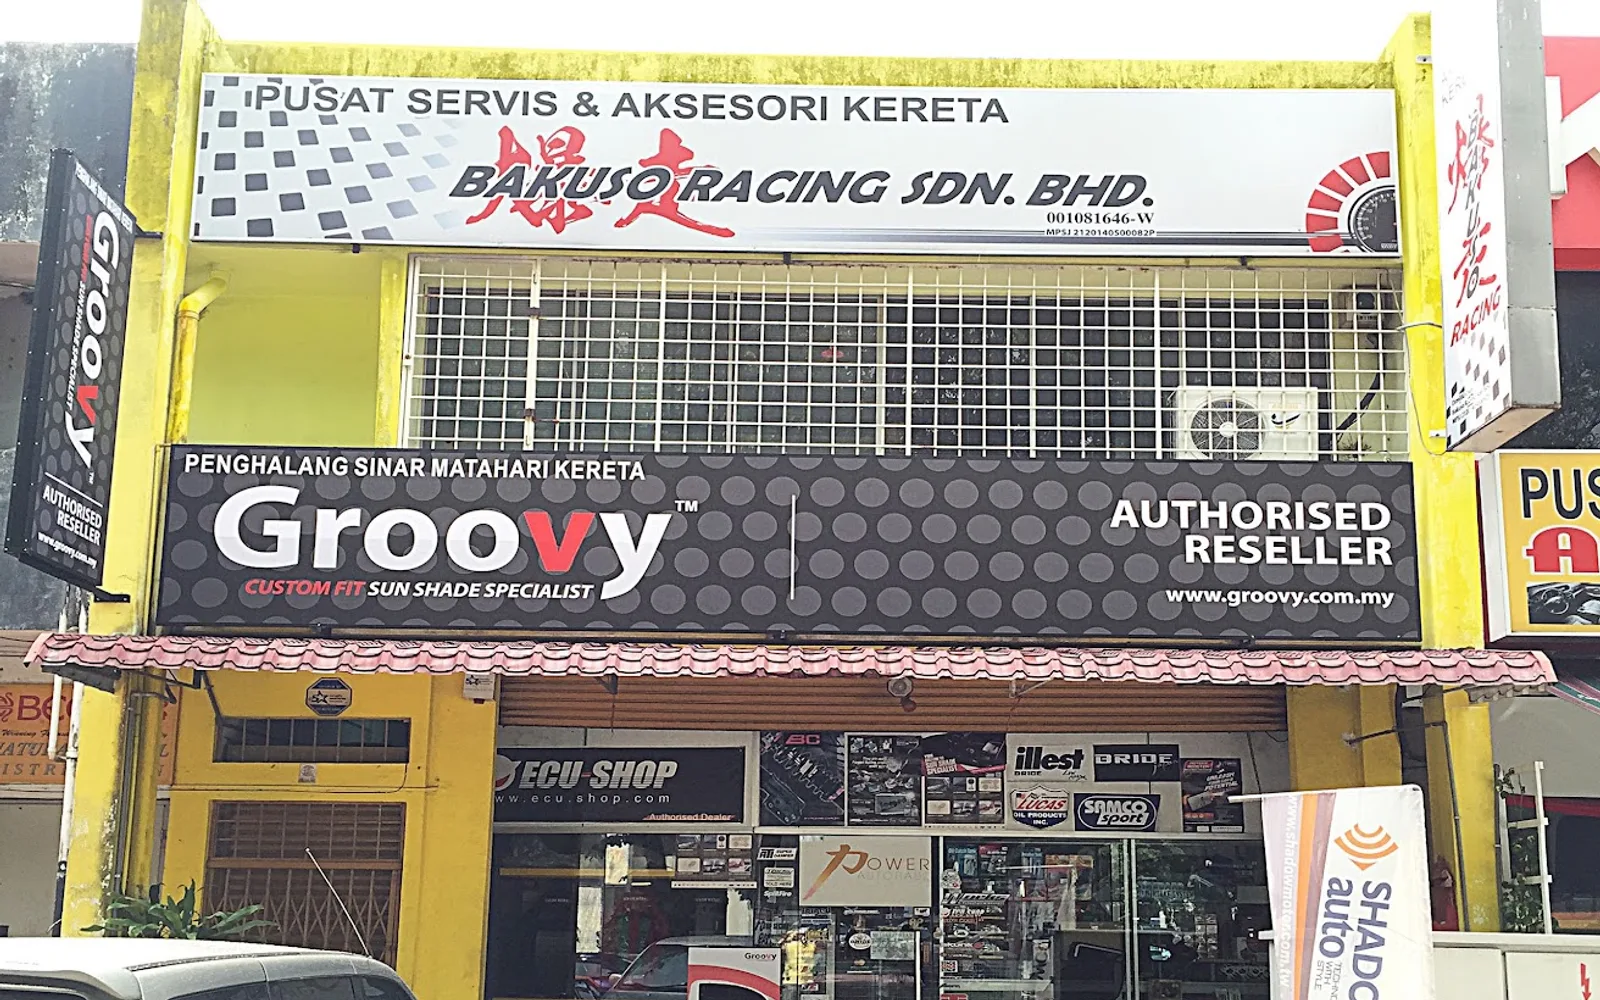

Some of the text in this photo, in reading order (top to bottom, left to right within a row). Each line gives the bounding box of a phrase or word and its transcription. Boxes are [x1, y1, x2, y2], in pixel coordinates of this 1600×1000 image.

[256, 85, 1009, 123] PUSAT SERVIS & AKSESORI KERETA
[449, 165, 1154, 208] BAKUSO RACING SDN. BHD.
[1046, 211, 1155, 225] 001081646-W
[1046, 228, 1072, 236] MPSJ
[1450, 285, 1501, 347] RACING
[64, 211, 120, 469] Groovy
[184, 454, 646, 481] PENGHALANG SINAR MATAHARI KERETA
[43, 485, 103, 529] AUTHORISED
[1110, 499, 1392, 531] AUTHORISED
[57, 510, 102, 547] RESELLER
[213, 485, 673, 600] Groovy
[1185, 534, 1393, 566] RESELLER
[245, 578, 595, 600] CUSTOM FIT SUN SHADE SPECIALIST
[1165, 588, 1395, 608] www.groovy.com.my
[1014, 746, 1085, 771] illest
[1094, 753, 1174, 765] BRIDE
[518, 760, 678, 789] ECU-SHOP
[649, 813, 732, 821] Authorised Dealer
[1016, 799, 1067, 810] LUCAS
[1084, 800, 1149, 815] SAMCO
[1100, 813, 1144, 826] sport
[1319, 876, 1355, 959] auto
[744, 952, 777, 961] Groovy
[1314, 960, 1325, 991] STYLE
